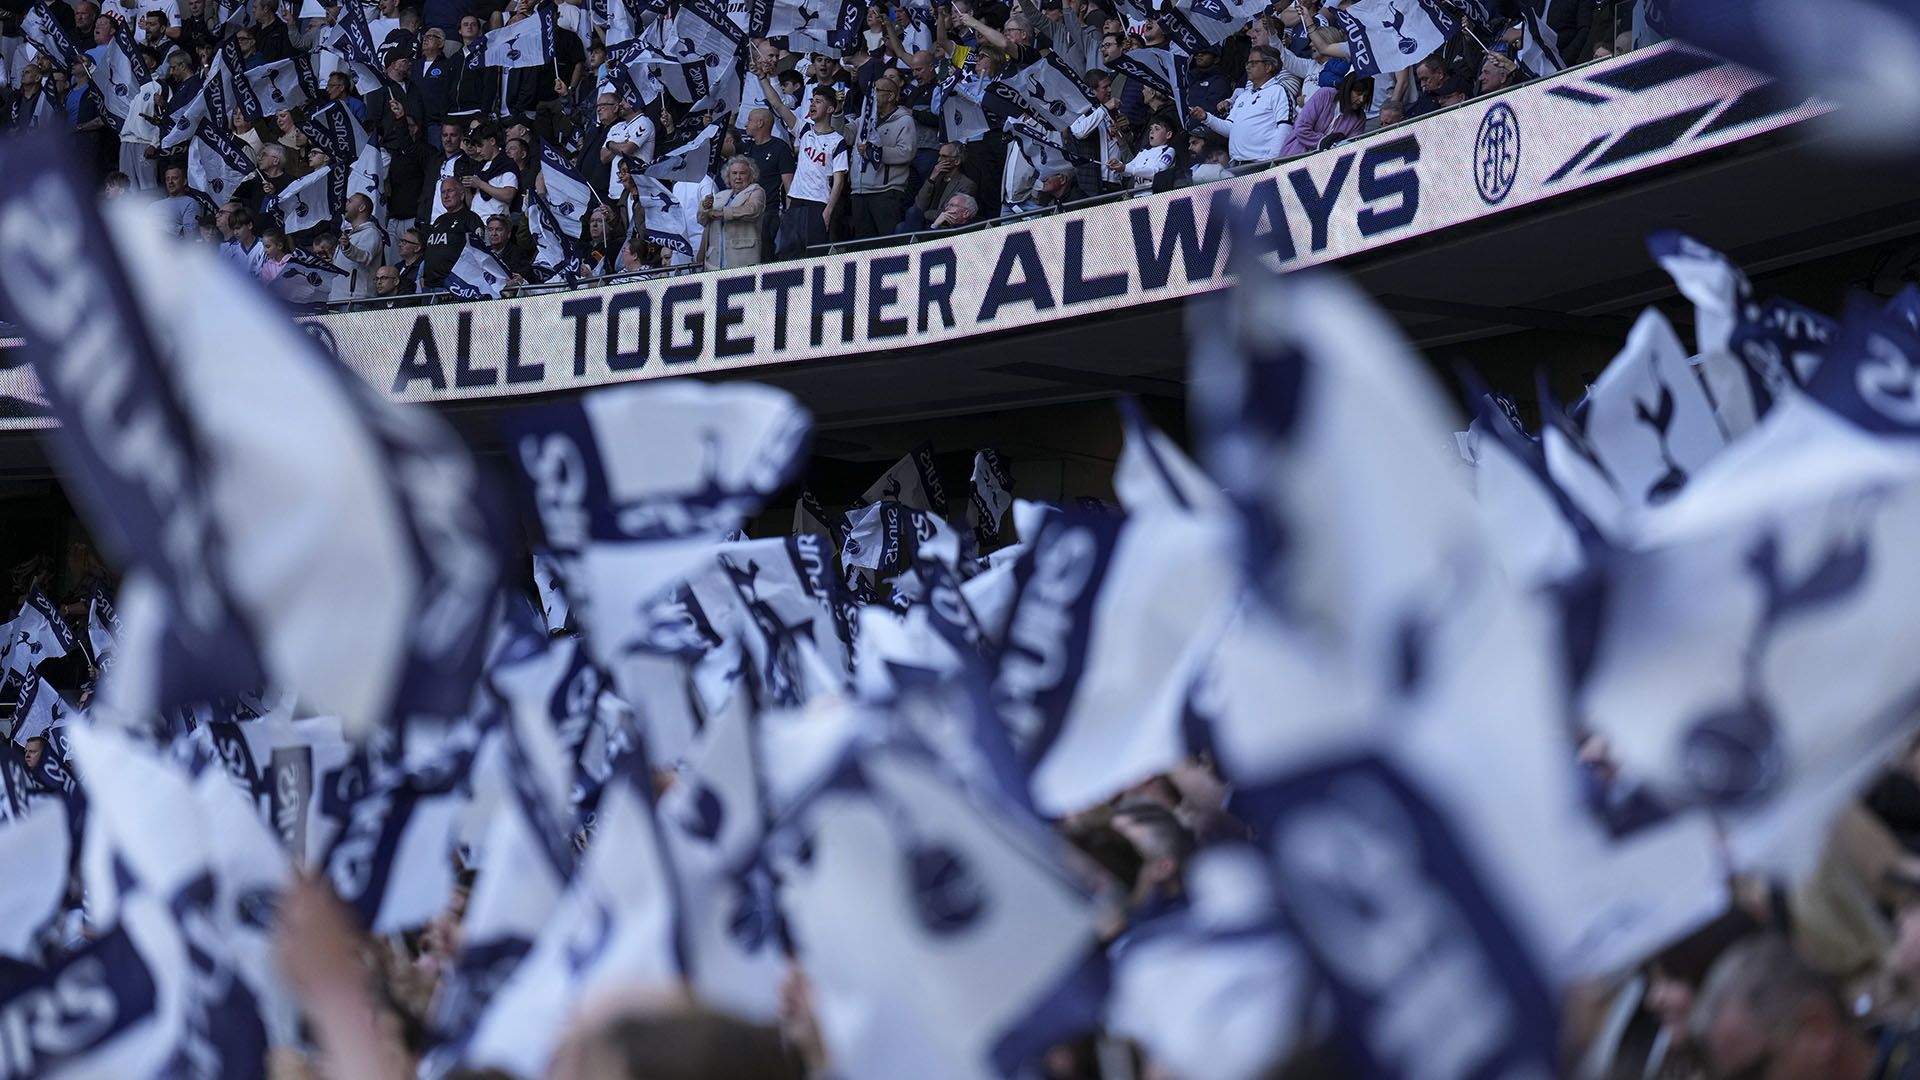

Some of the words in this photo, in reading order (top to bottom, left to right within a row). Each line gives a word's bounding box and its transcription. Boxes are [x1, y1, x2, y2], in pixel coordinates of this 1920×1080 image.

[752, 0, 767, 32] SPU
[332, 112, 350, 152] SPURS
[427, 232, 448, 246] AIA
[391, 306, 544, 393] ALL
[562, 245, 957, 377] TOGETHER
[976, 133, 1421, 323] ALWAYS
